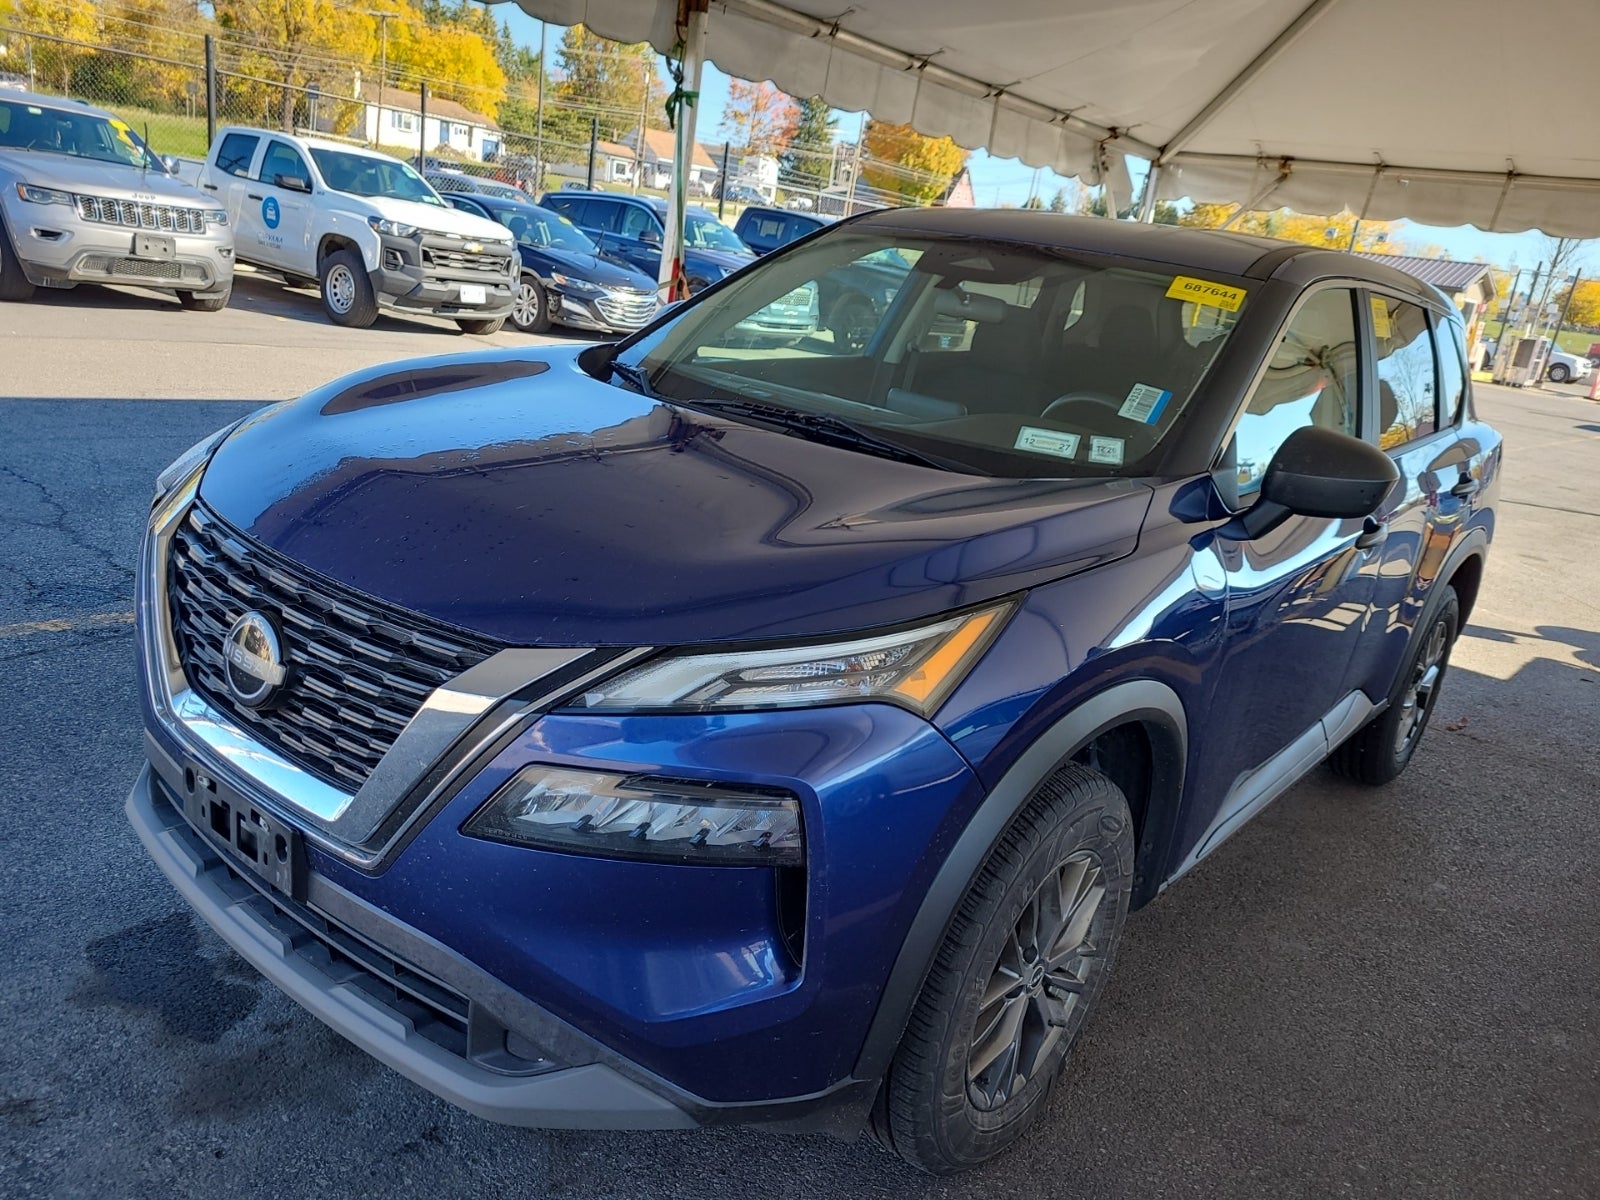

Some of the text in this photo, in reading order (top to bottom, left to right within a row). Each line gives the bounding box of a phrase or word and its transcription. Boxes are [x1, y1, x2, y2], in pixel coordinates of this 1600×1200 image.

[257, 231, 283, 244] RVANA
[1184, 282, 1237, 300] 687644
[1058, 443, 1071, 452] 27
